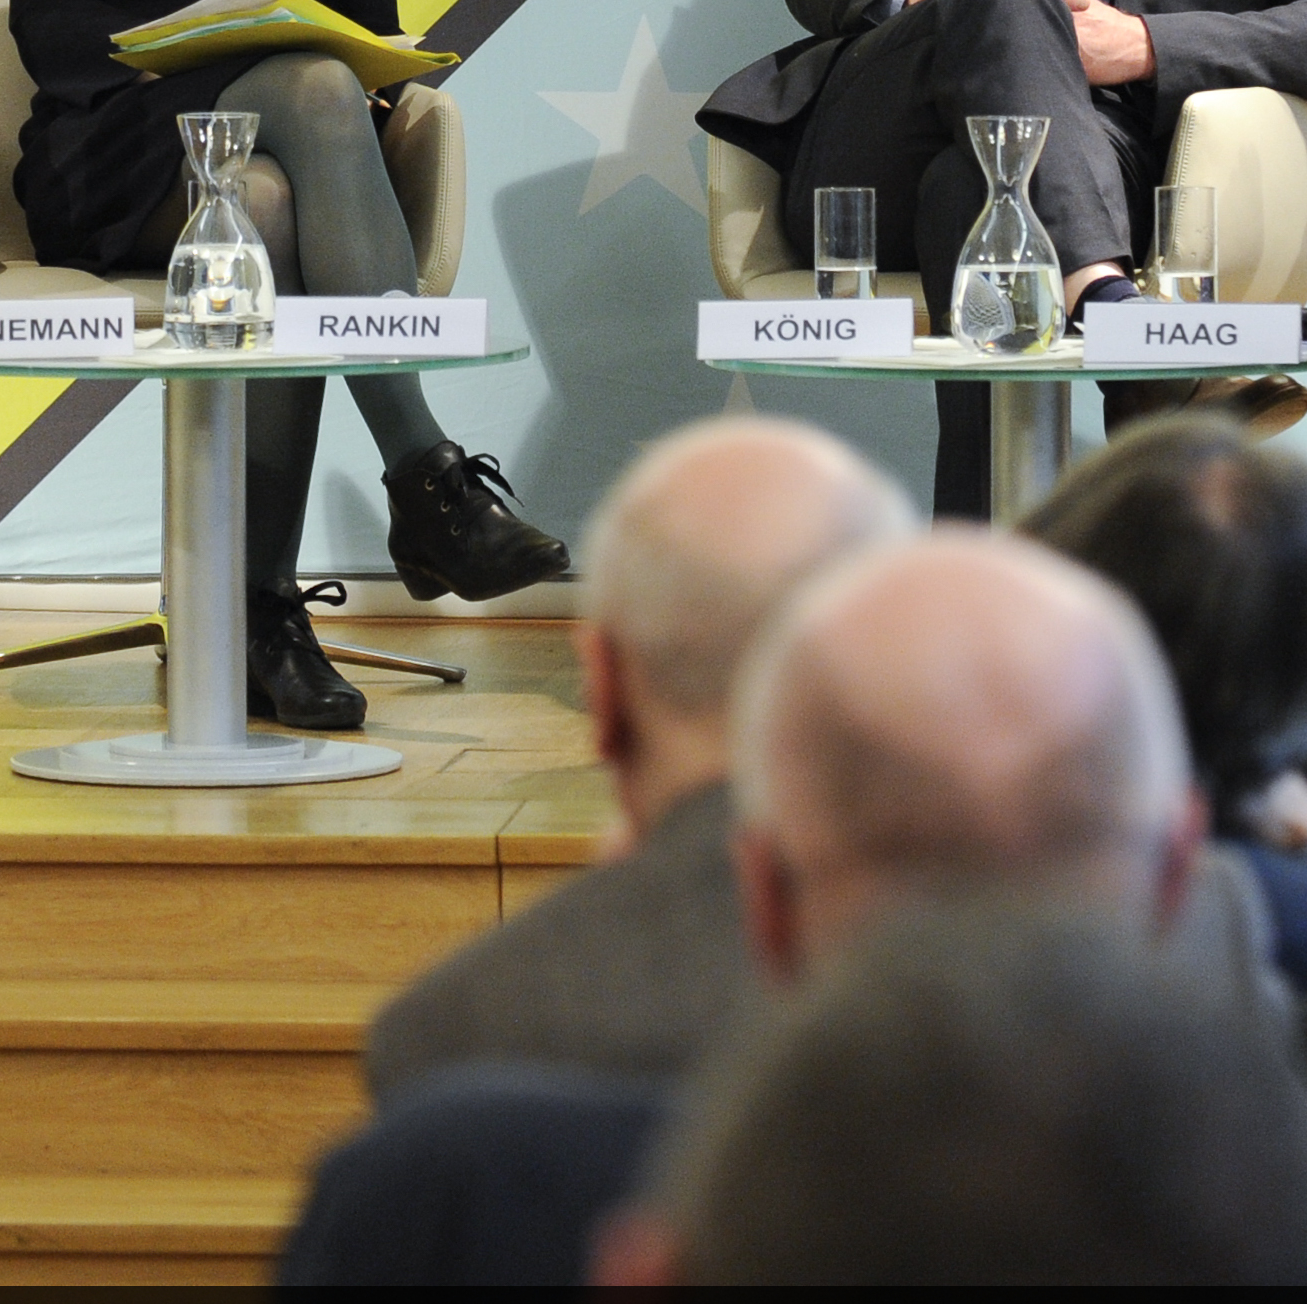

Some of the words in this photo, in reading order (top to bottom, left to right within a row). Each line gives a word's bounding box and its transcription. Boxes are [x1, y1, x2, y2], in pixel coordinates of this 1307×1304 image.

[319, 315, 441, 338] RANKIN
[754, 314, 857, 342] KÖNIG
[1144, 322, 1239, 346] HAAG
